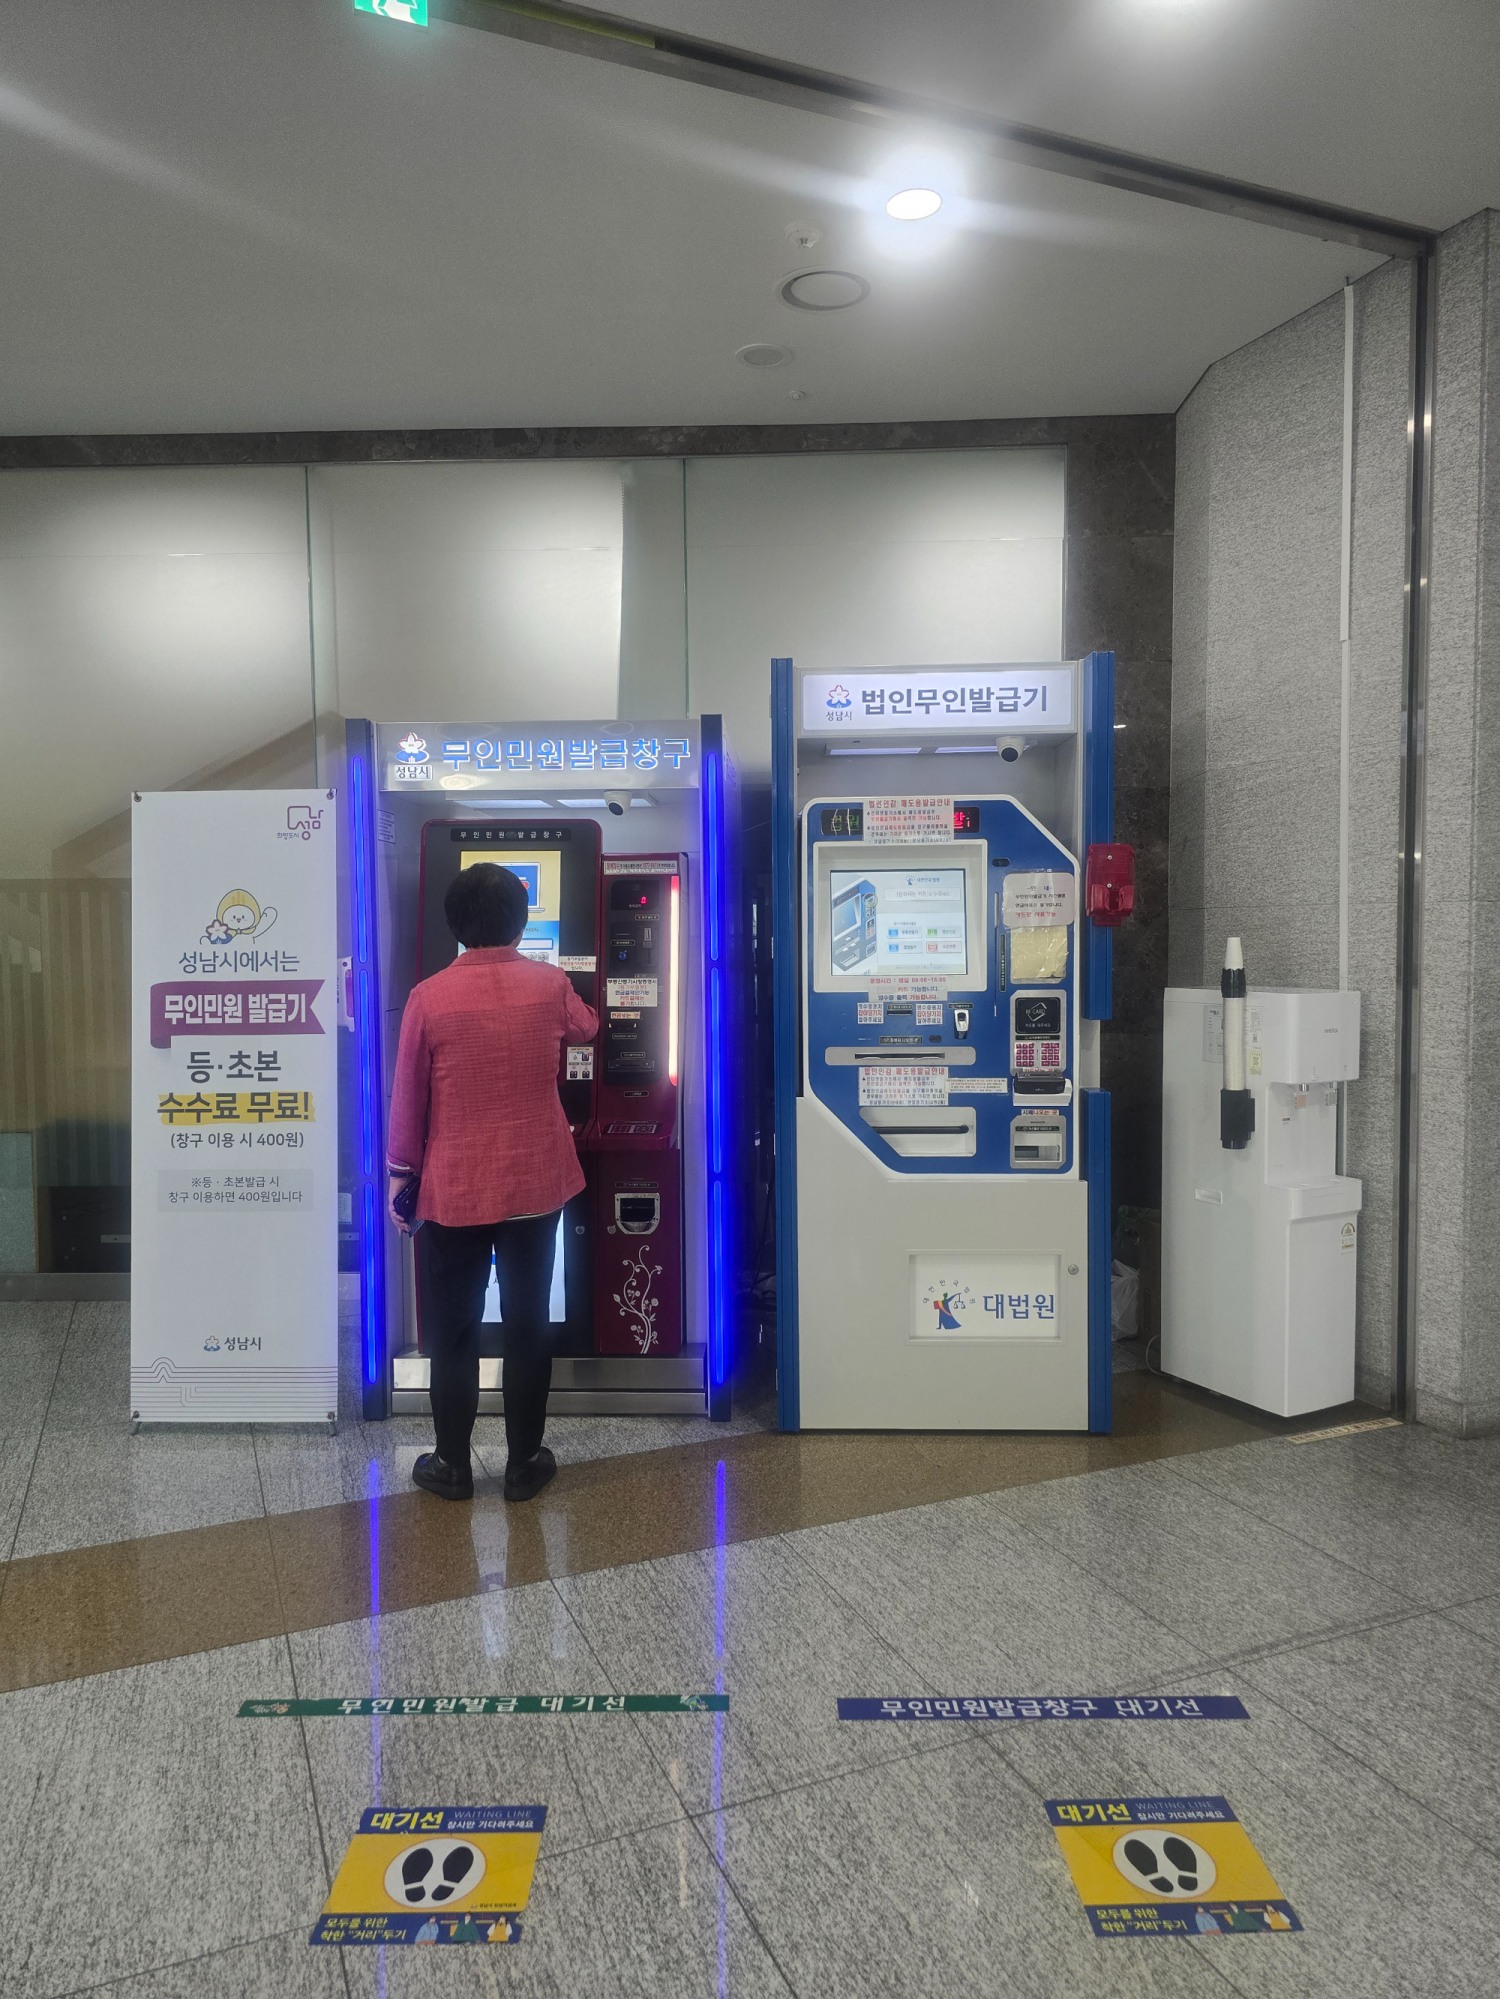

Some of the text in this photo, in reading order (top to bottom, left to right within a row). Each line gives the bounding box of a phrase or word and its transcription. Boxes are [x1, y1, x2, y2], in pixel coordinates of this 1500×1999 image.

[862, 686, 1047, 716] 법인무인발급기
[826, 711, 852, 722] 성남시
[442, 738, 691, 771] 무인민원발급창구
[395, 766, 430, 779] 성남시
[179, 950, 300, 974] 성남시에서는
[164, 992, 306, 1024] 무인민원 발급기
[187, 1050, 281, 1083] 등·초본
[158, 1092, 309, 1123] 수수료 무료!
[171, 1132, 304, 1148] (창구 이용 시 400원)
[224, 1176, 266, 1188] 초본발급
[270, 1176, 280, 1188] 시
[168, 1191, 302, 1203] 창구 이용하면 400원입니다
[983, 1294, 1054, 1319] 대법원
[224, 1337, 262, 1350] 성남시
[541, 1696, 626, 1711] 대기선
[880, 1698, 1203, 1718] 무인민원발급창구 대기선
[1136, 1800, 1214, 1810] WAITING LINE
[506, 1810, 532, 1818] LINE
[1057, 1804, 1132, 1822] 대기선
[1136, 1810, 1225, 1820] 잠시만 기다려주세요
[370, 1812, 444, 1830] 대기선
[447, 1820, 534, 1829] 잠시만 기다려주세요
[1096, 1908, 1158, 1920] 모두를 위한
[325, 1917, 388, 1928] 모두를 위한
